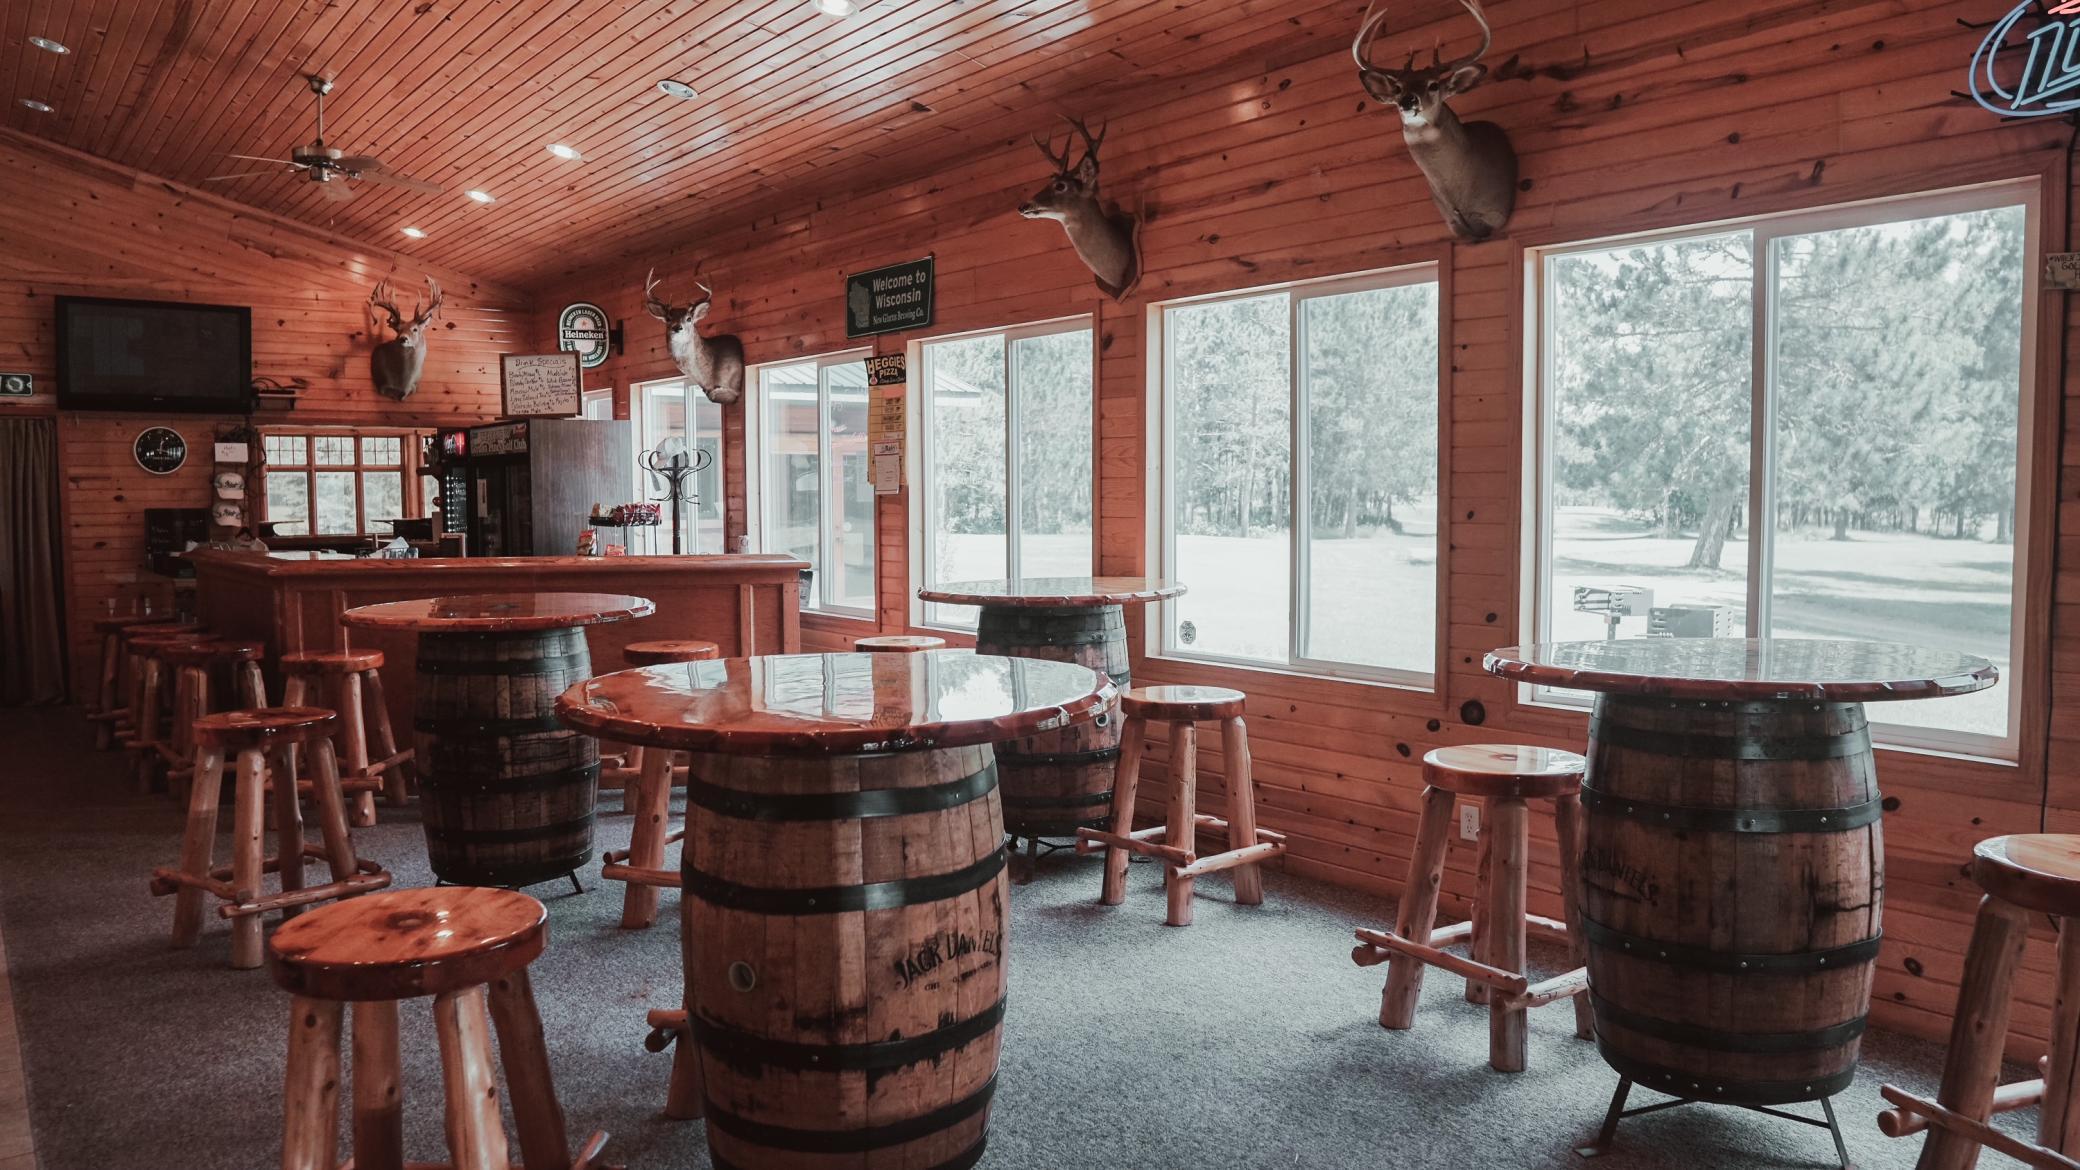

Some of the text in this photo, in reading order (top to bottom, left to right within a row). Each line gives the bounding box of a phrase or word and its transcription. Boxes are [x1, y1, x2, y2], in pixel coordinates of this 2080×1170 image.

[873, 269, 926, 293] Welcome to
[875, 288, 922, 309] Wisconsin
[564, 330, 604, 339] Heineken
[515, 357, 567, 367] Drink Specials
[866, 356, 905, 375] HEGGIES
[879, 368, 898, 378] PIZZA
[894, 936, 944, 990] JACK
